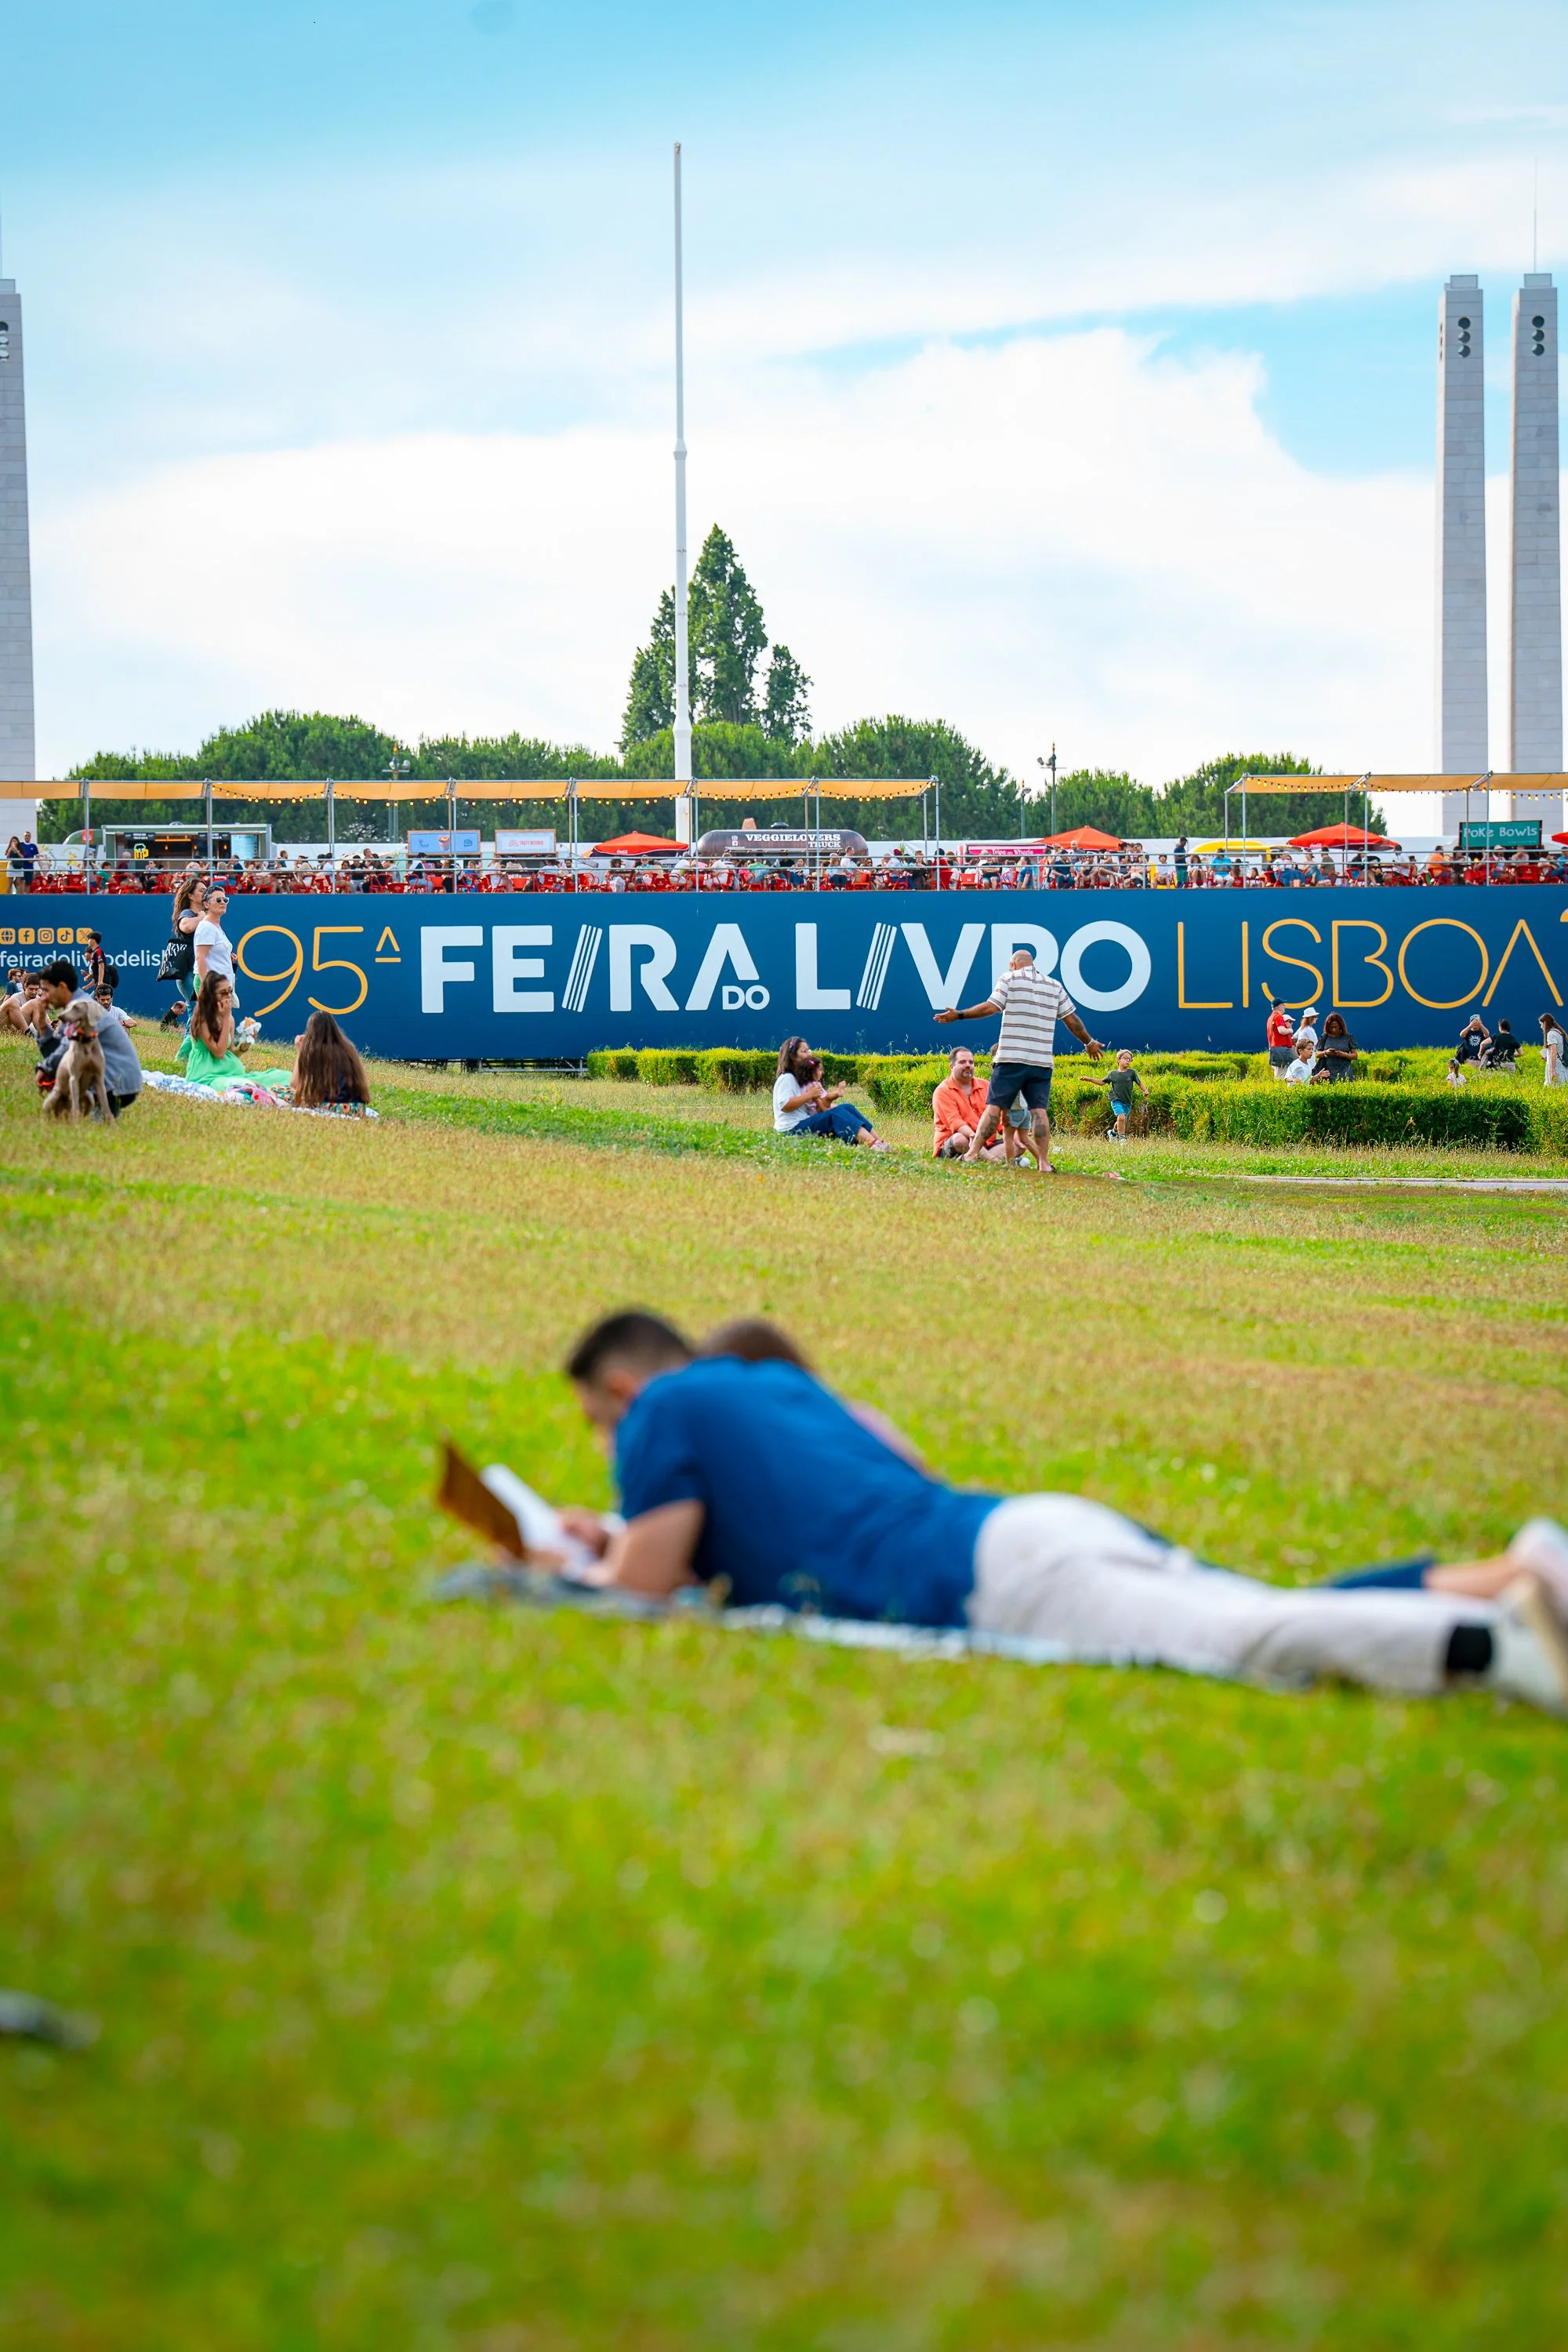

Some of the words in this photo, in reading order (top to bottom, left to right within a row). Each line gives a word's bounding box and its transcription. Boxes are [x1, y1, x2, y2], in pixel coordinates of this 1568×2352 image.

[745, 833, 841, 842] VEGGIELOVERS
[1499, 826, 1537, 837] Bowls
[0, 949, 165, 968] feiradolivodelis
[722, 985, 771, 1011] DO
[1178, 918, 1564, 1010] LISBOA
